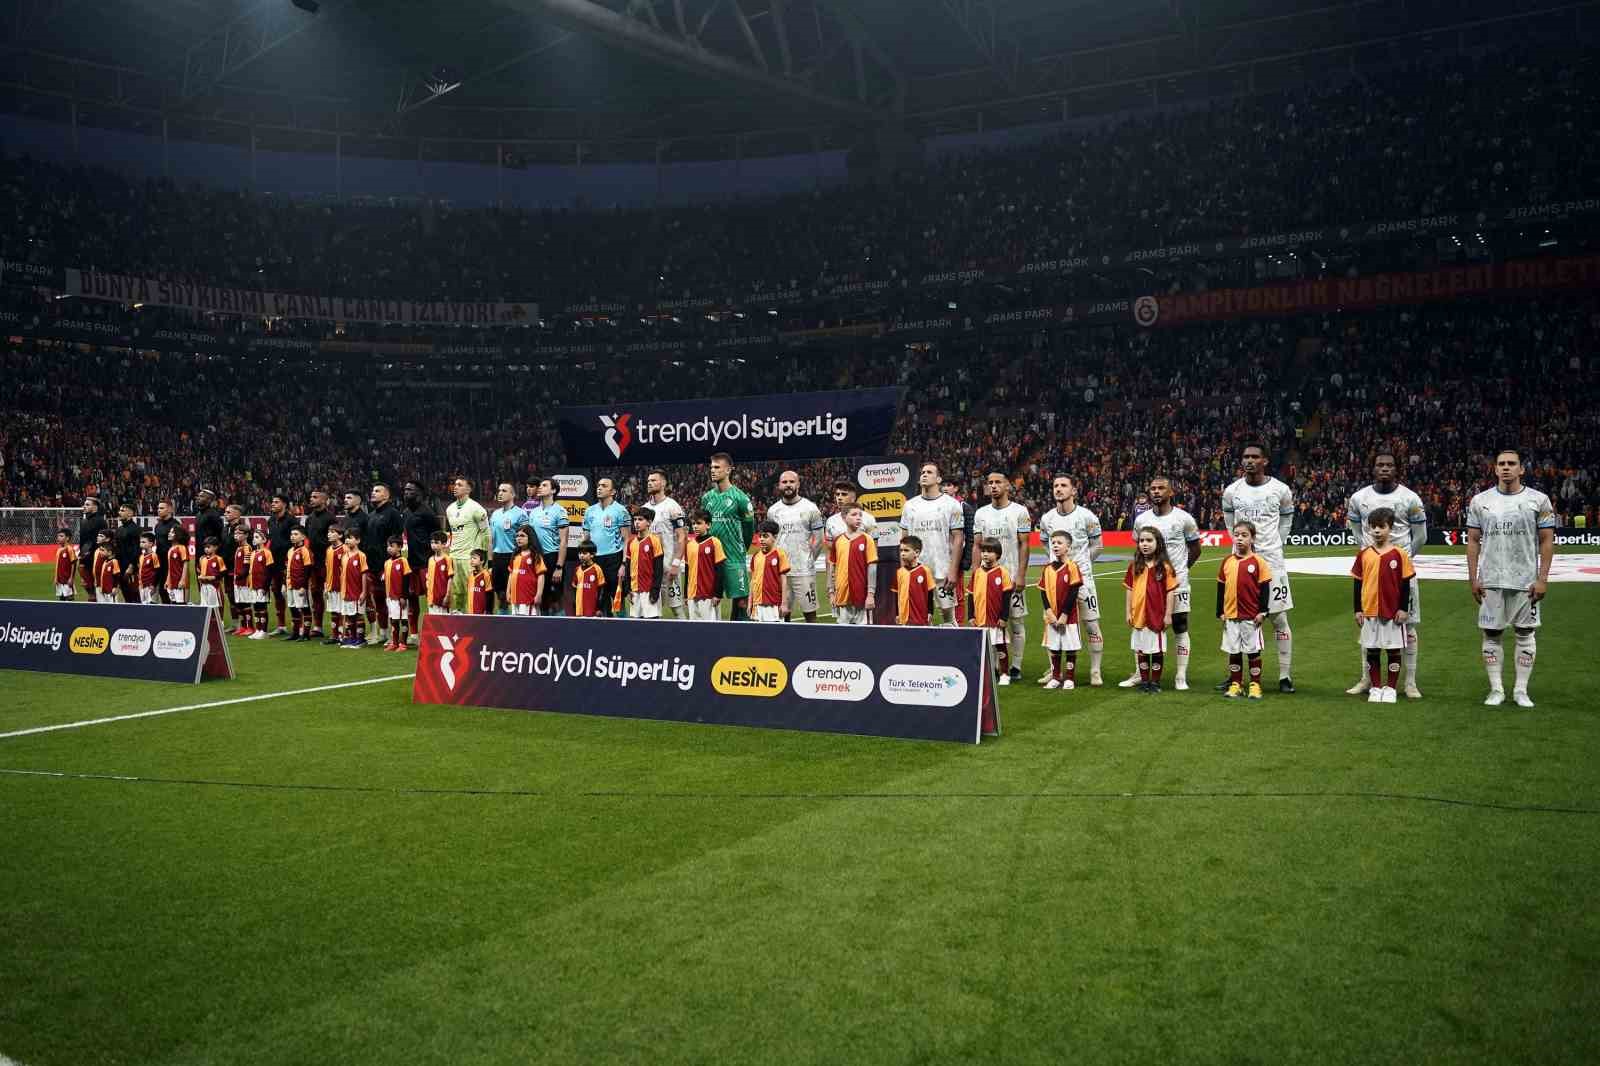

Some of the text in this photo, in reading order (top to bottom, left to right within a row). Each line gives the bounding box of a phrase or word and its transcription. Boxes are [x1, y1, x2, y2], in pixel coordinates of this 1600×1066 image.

[1517, 202, 1561, 217] RAMS
[1377, 214, 1459, 233] RAMS PARK
[1250, 231, 1324, 249] RAMS PARK
[1133, 244, 1200, 261] RAMS PARK
[1026, 257, 1089, 273] RAMS PARK
[958, 269, 985, 281] PARK
[1096, 300, 1129, 313] RAMS
[992, 308, 1053, 323] RAMS PARK
[636, 414, 747, 446] trendyol
[866, 465, 901, 477] trendyol
[1284, 531, 1345, 547] rendyol
[668, 586, 682, 599] 33
[805, 589, 816, 603] 15
[1272, 586, 1288, 601] 29
[1087, 596, 1097, 609] 10
[479, 645, 593, 682] trendyol
[806, 666, 861, 682] trendyol
[815, 682, 851, 694] yemek
[888, 679, 943, 689] Türk Telekom
